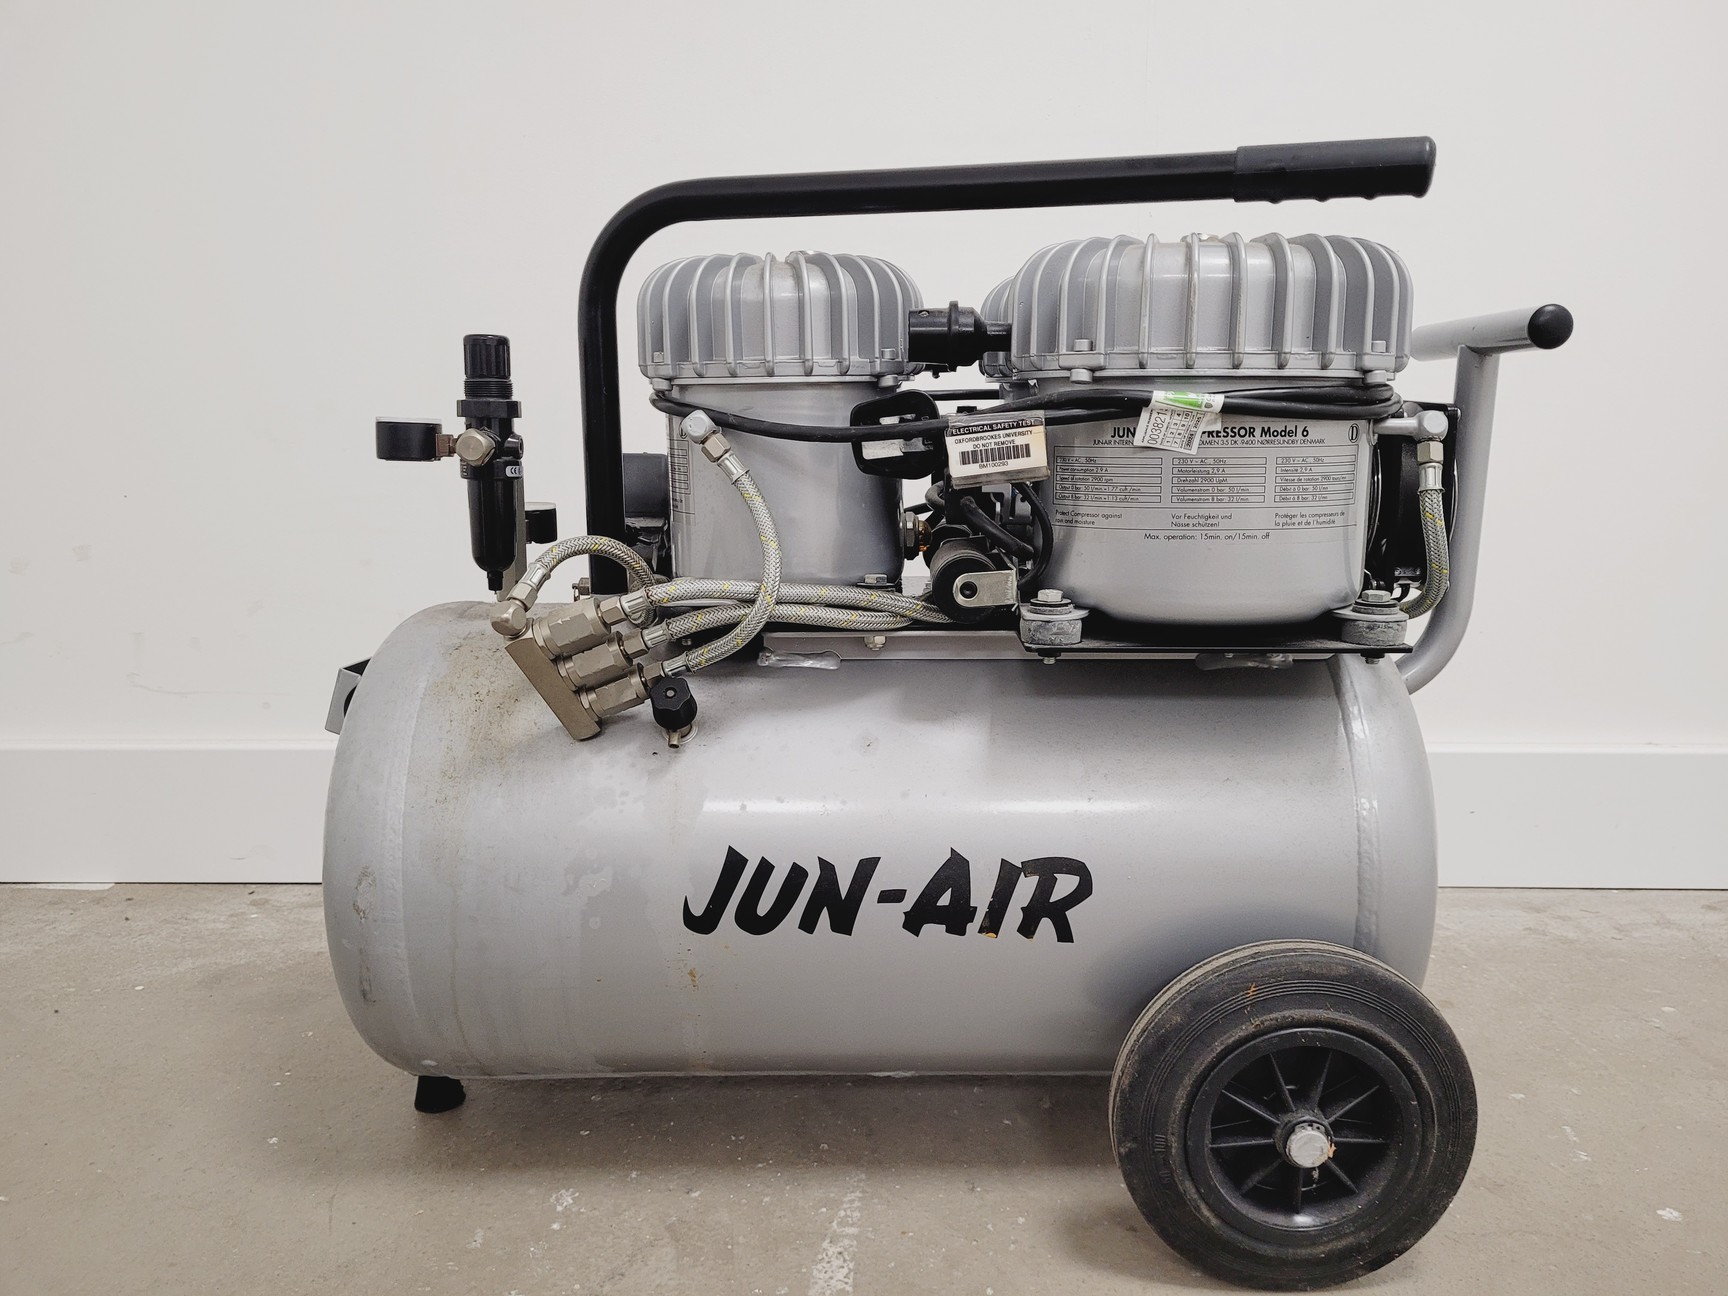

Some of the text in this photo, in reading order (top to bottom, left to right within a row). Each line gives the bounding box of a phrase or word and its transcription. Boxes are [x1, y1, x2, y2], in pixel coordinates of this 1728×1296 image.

[952, 419, 1035, 435] ELECTRICAL SAFETY TEST
[1200, 425, 1310, 439] PRESSOR Model 6
[1002, 429, 1033, 439] UNIVERSITY
[1111, 426, 1137, 439] JUN
[993, 439, 1016, 447] REMOVE
[1177, 467, 1210, 475] Motorleistung
[1070, 509, 1100, 519] Compressor
[1101, 512, 1123, 520] against
[1171, 512, 1233, 521] Vor Feuchtigkeit und
[1299, 511, 1307, 519] les
[1308, 511, 1339, 520] compresseurs
[1274, 519, 1281, 527] la
[1281, 519, 1296, 528] pluie
[1143, 531, 1271, 542] Max. operation: 15min. on/15min. off
[681, 844, 1094, 944] JUN-AIR
